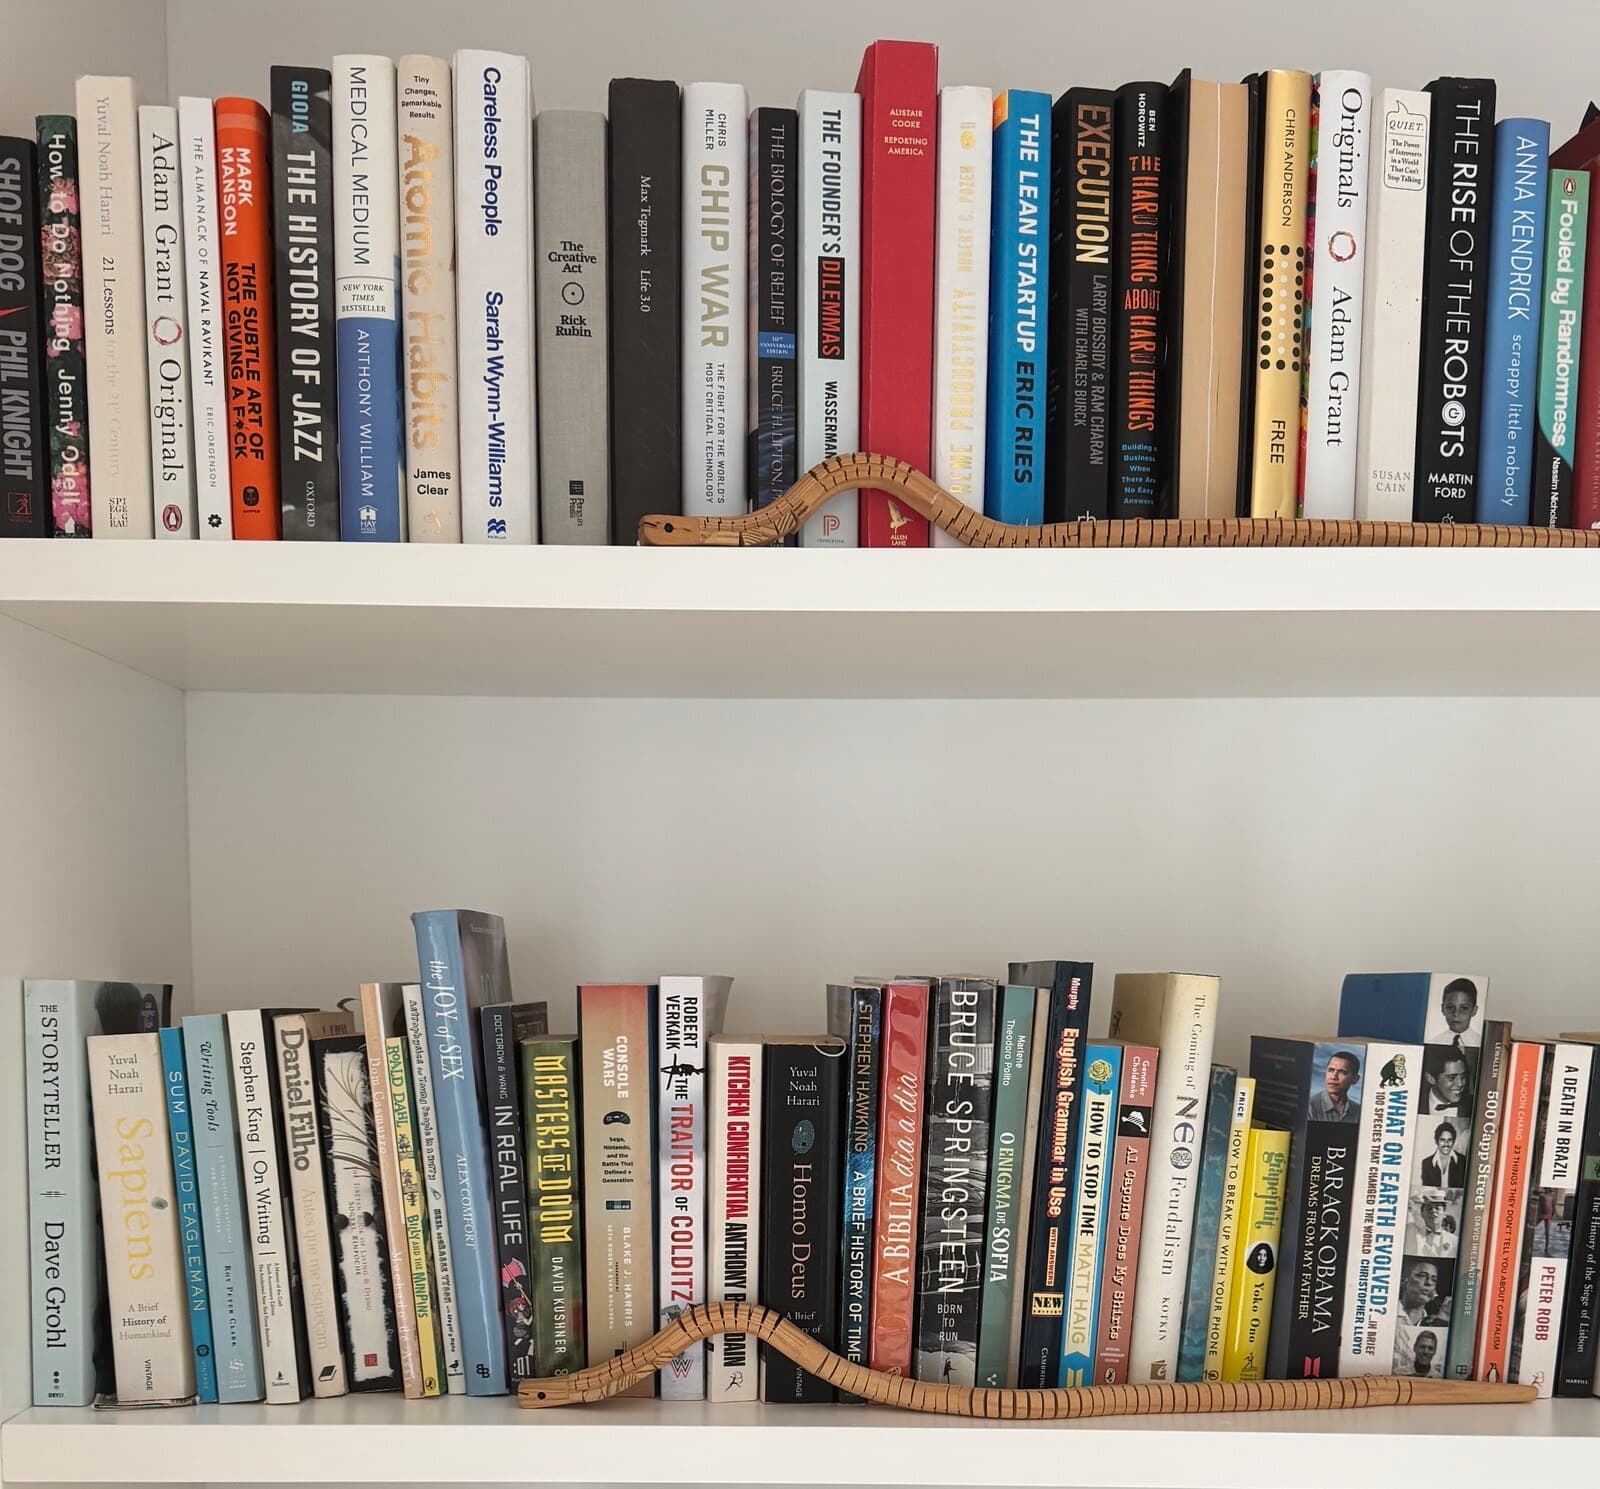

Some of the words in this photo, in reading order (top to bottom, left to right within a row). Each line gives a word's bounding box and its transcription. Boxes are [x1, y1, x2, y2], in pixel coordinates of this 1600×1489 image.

[291, 81, 309, 134] GIOIA
[405, 88, 437, 96] Changes,
[483, 67, 502, 158] Careless
[350, 67, 368, 167] MEDICAL
[706, 109, 715, 150] MILLER
[718, 113, 726, 147] CHRIS
[891, 120, 919, 128] COOKE
[1020, 114, 1039, 161] THE
[1285, 109, 1295, 148] CHRIS
[1389, 119, 1424, 131] QUIET.
[47, 134, 67, 180] How
[193, 137, 203, 160] THE
[888, 147, 924, 155] AMERICA
[1334, 88, 1363, 208] Originals
[1513, 137, 1538, 201] ANNA
[152, 132, 174, 212] Adam
[220, 147, 238, 237] MANSON
[236, 147, 252, 205] MARK
[287, 150, 317, 204] THE
[639, 175, 651, 203] Max
[1076, 104, 1111, 263] EXECUTION
[1281, 152, 1295, 227] ANDERSON
[48, 192, 67, 215] to
[194, 166, 208, 242] ALMANACK
[351, 173, 370, 265] MEDIUM
[481, 165, 502, 236] People
[701, 164, 730, 252] CHIP
[1019, 171, 1038, 235] LEAN
[51, 224, 69, 253] Do
[560, 242, 584, 251] The
[637, 206, 651, 256] Tegmark
[156, 224, 178, 303] Grant
[198, 248, 208, 266] OF
[288, 215, 318, 339] HISTORY
[548, 252, 597, 263] Creative
[563, 264, 583, 273] Act
[1508, 209, 1534, 320] KENDRICK
[199, 271, 210, 315] NAVAL
[640, 270, 651, 292] Life
[640, 295, 651, 312] 3.0
[1017, 243, 1037, 352] STARTUP
[52, 263, 74, 352] Nothing
[341, 305, 386, 313] BESTSELLER
[485, 291, 504, 351] Sarah
[561, 315, 587, 325] Rick
[701, 264, 730, 348] WAR
[1330, 286, 1352, 362] Adam
[201, 319, 214, 386] RAVIKANT
[556, 326, 592, 337] Rubin
[0, 329, 30, 383] PHIL
[291, 348, 320, 384] OF
[357, 329, 373, 415] ANTHONY
[1507, 334, 1523, 398] scrappy
[717, 387, 725, 414] FIGHT
[1016, 361, 1034, 420] ERIC
[1327, 372, 1349, 447] Grant
[2, 389, 33, 480] KNIGHT
[154, 359, 184, 482] Originals
[293, 393, 322, 463] JAZZ
[485, 355, 506, 507] Wynn-Williams
[717, 417, 725, 435] FOR
[1271, 419, 1286, 464] FREE
[1508, 404, 1524, 441] little
[359, 424, 374, 496] WILLIAM
[717, 439, 725, 457] THE
[1015, 426, 1033, 483] RIES
[414, 470, 451, 479] James
[418, 485, 449, 495] Clear
[717, 460, 725, 504] WORLD'S
[1373, 471, 1410, 480] SUSAN
[1377, 482, 1406, 491] CAIN
[1428, 473, 1472, 484] MARTIN
[1435, 488, 1466, 498] FORD
[1502, 446, 1519, 506] nobody
[40, 1004, 58, 1013] THE
[666, 995, 681, 1050] VERKAIK
[683, 997, 698, 1048] ROBERT
[947, 991, 977, 1086] BRUCE
[200, 1041, 215, 1095] Writing
[239, 1041, 258, 1102] Stephen
[281, 1029, 310, 1108] Daniel
[603, 1048, 615, 1087] WARS
[616, 1035, 628, 1098] CONSOLE
[675, 1079, 688, 1099] THE
[727, 1056, 750, 1116] KITCHEN
[42, 1017, 60, 1170] STORYTELLER
[169, 1071, 184, 1113] SUM
[1561, 1078, 1578, 1116] DEATH
[205, 1101, 219, 1132] Tools
[245, 1107, 264, 1142] King
[494, 1105, 514, 1129] IN
[1091, 1102, 1105, 1137] HOW
[1557, 1121, 1572, 1133] IN
[175, 1131, 194, 1193] DAVID
[289, 1112, 313, 1171] Filho
[670, 1104, 693, 1190] TRAITOR
[1088, 1142, 1102, 1158] TO
[1232, 1130, 1242, 1159] HOW
[1552, 1137, 1572, 1180] BRAZIL
[253, 1161, 269, 1184] On
[498, 1135, 517, 1194] REAL
[726, 1121, 750, 1219] CONFIDENTIAL
[1085, 1164, 1100, 1199] STOP
[1229, 1164, 1238, 1178] TO
[1307, 1156, 1321, 1208] DREAMS
[109, 1119, 155, 1281] Sapiens
[255, 1188, 272, 1245] Writing
[674, 1197, 687, 1211] OF
[792, 1163, 811, 1234] Homo
[938, 1101, 973, 1293] SPRINGSTEEN
[1224, 1184, 1236, 1221] BREAK
[1319, 1146, 1346, 1242] BARACK
[502, 1201, 521, 1245] LIFE
[1080, 1204, 1097, 1236] TIME
[1223, 1226, 1232, 1240] UP
[1304, 1211, 1317, 1246] FROM
[44, 1221, 64, 1279] Dave
[183, 1203, 205, 1312] EAGLEMAN
[623, 1227, 632, 1264] BLAKE
[670, 1216, 693, 1301] COLDITZ
[1219, 1245, 1230, 1274] WITH
[1302, 1249, 1314, 1269] MY
[551, 1257, 564, 1293] DAVID
[623, 1268, 632, 1280] J.
[791, 1242, 810, 1299] Deus
[1311, 1245, 1337, 1334] OBAMA
[1540, 1266, 1557, 1303] PETER
[46, 1286, 66, 1349] Grohl
[624, 1284, 633, 1327] HARRIS
[938, 1304, 963, 1313] BORN
[1214, 1279, 1226, 1311] YOUR
[1298, 1272, 1312, 1319] FATHER
[553, 1298, 566, 1354] KUSHNER
[938, 1331, 958, 1340] RUN
[943, 1318, 954, 1327] TO
[1209, 1317, 1221, 1356] PHONE
[1534, 1308, 1552, 1341] ROBB
